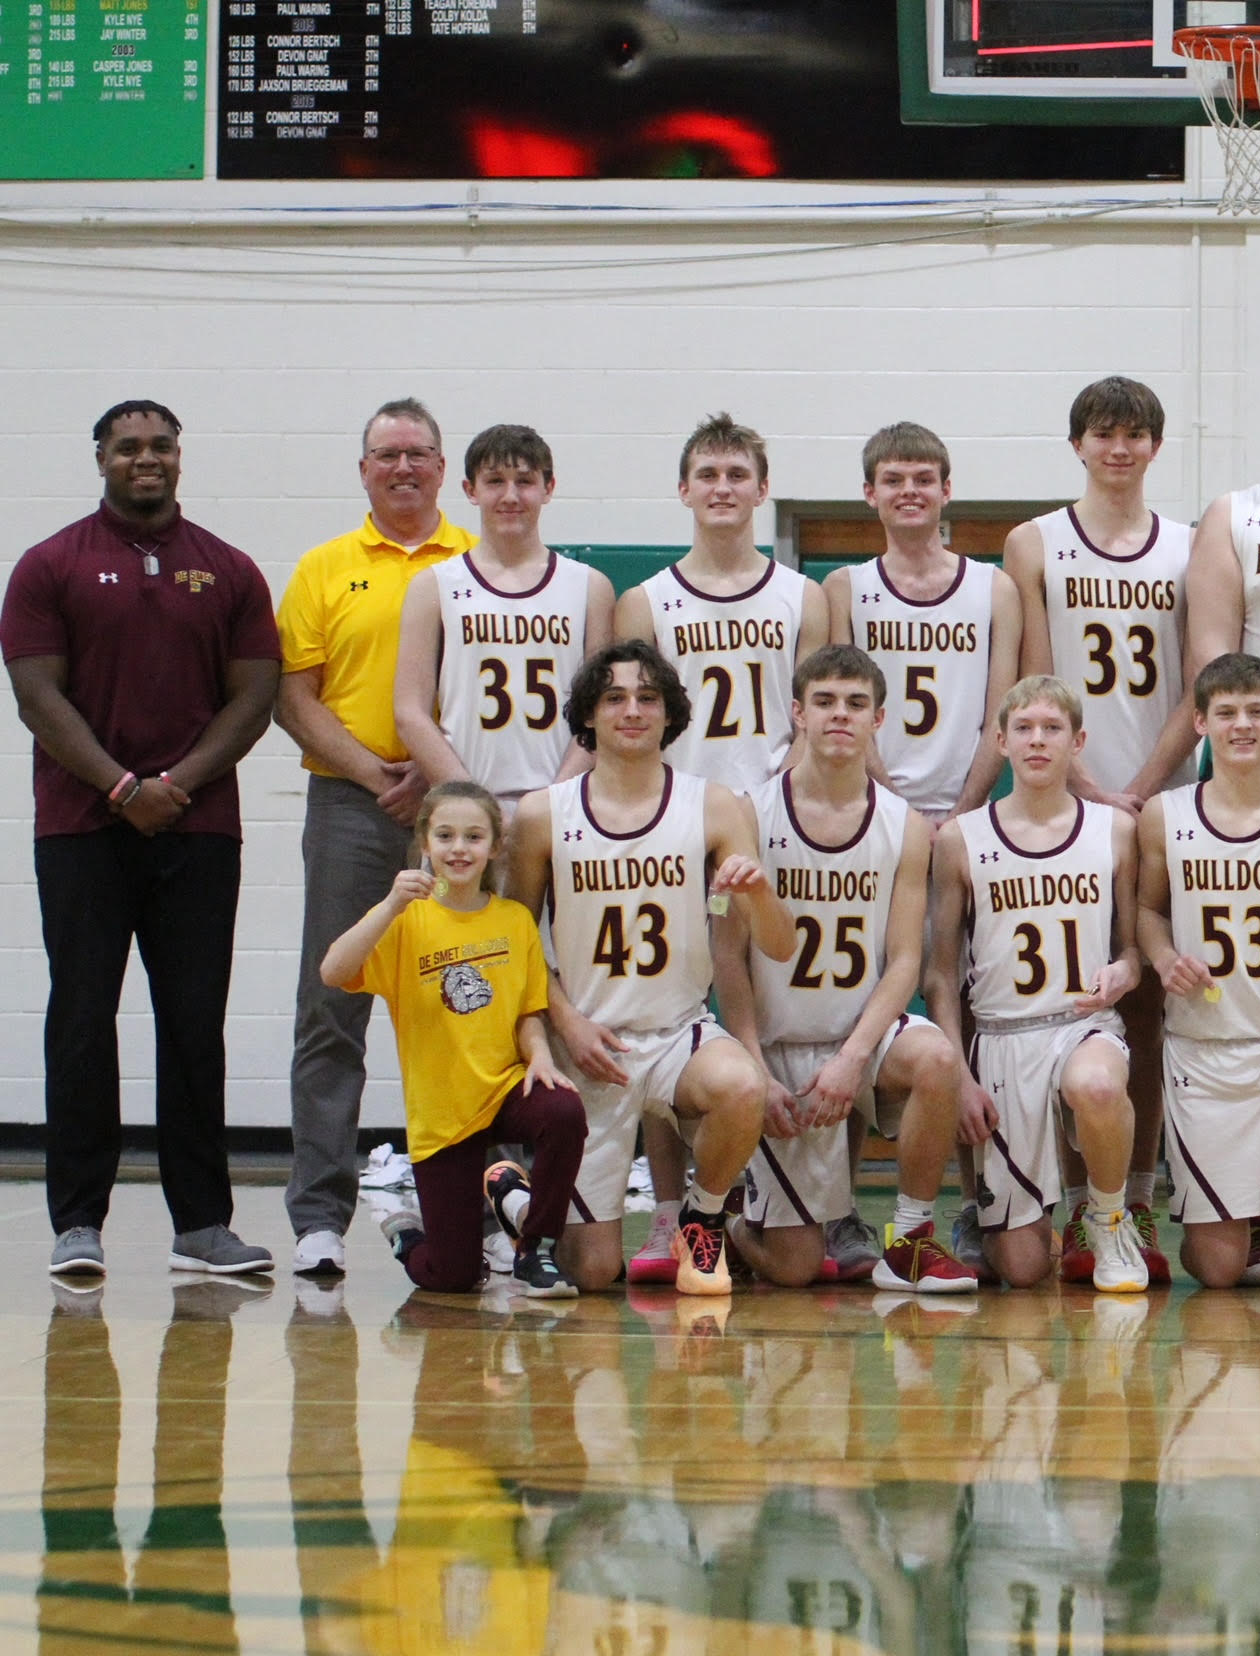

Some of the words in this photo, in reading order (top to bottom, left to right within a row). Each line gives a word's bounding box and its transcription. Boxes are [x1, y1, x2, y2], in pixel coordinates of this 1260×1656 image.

[241, 4, 255, 15] LBS
[277, 4, 297, 15] PAUL
[299, 4, 331, 15] WARING
[366, 4, 379, 15] 5TH
[397, 0, 411, 9] LBS
[424, 0, 456, 9] TEAGAN
[62, 14, 75, 25] LBS
[105, 14, 125, 25] KYLE
[127, 14, 142, 25] NYE
[185, 14, 199, 25] 4TH
[397, 10, 411, 21] LBS
[431, 10, 459, 21] COLBY
[461, 10, 488, 21] KOLDA
[62, 29, 75, 40] LBS
[101, 29, 114, 40] JAY
[116, 29, 146, 40] WINTER
[397, 23, 411, 34] LBS
[431, 23, 450, 34] TATE
[451, 23, 490, 34] HOFFMAN
[241, 35, 255, 47] LBS
[267, 35, 301, 47] CONNOR
[303, 35, 340, 47] BERTSCH
[112, 45, 135, 56] 2003
[241, 50, 255, 62] LBS
[278, 50, 305, 62] DEVON
[307, 50, 328, 62] GNAT
[61, 60, 75, 72] LBS
[93, 60, 125, 72] CASPER
[127, 60, 152, 72] JONES
[241, 65, 254, 77] LBS
[276, 65, 297, 77] PAUL
[298, 65, 330, 77] WARING
[61, 75, 75, 87] LBS
[104, 75, 123, 87] KYLE
[126, 75, 141, 87] NYE
[240, 79, 254, 92] LBS
[258, 79, 290, 92] JAXSON
[292, 79, 348, 92] BRUEGGEMAN
[240, 112, 253, 123] LBS
[266, 112, 300, 123] CONNOR
[302, 112, 339, 123] BERTSCH
[240, 127, 253, 138] LBS
[277, 127, 304, 138] DEVON
[306, 127, 327, 138] GNAT
[1065, 577, 1175, 611] BULLDOGS
[461, 614, 571, 646] BULLDOGS
[674, 618, 784, 657] BULLDOGS
[866, 621, 977, 653] BULLDOGS
[1083, 622, 1158, 698] 33
[478, 657, 559, 733] 35
[701, 660, 767, 740] 21
[903, 665, 939, 738] 5
[571, 855, 686, 894] BULLDOGS
[776, 867, 879, 902] BULLDOGS
[988, 872, 1101, 914] BULLDOGS
[591, 902, 669, 981] 43
[419, 955, 431, 970] DE
[433, 946, 460, 965] SMET
[788, 914, 867, 990] 25
[1013, 918, 1090, 996] 31
